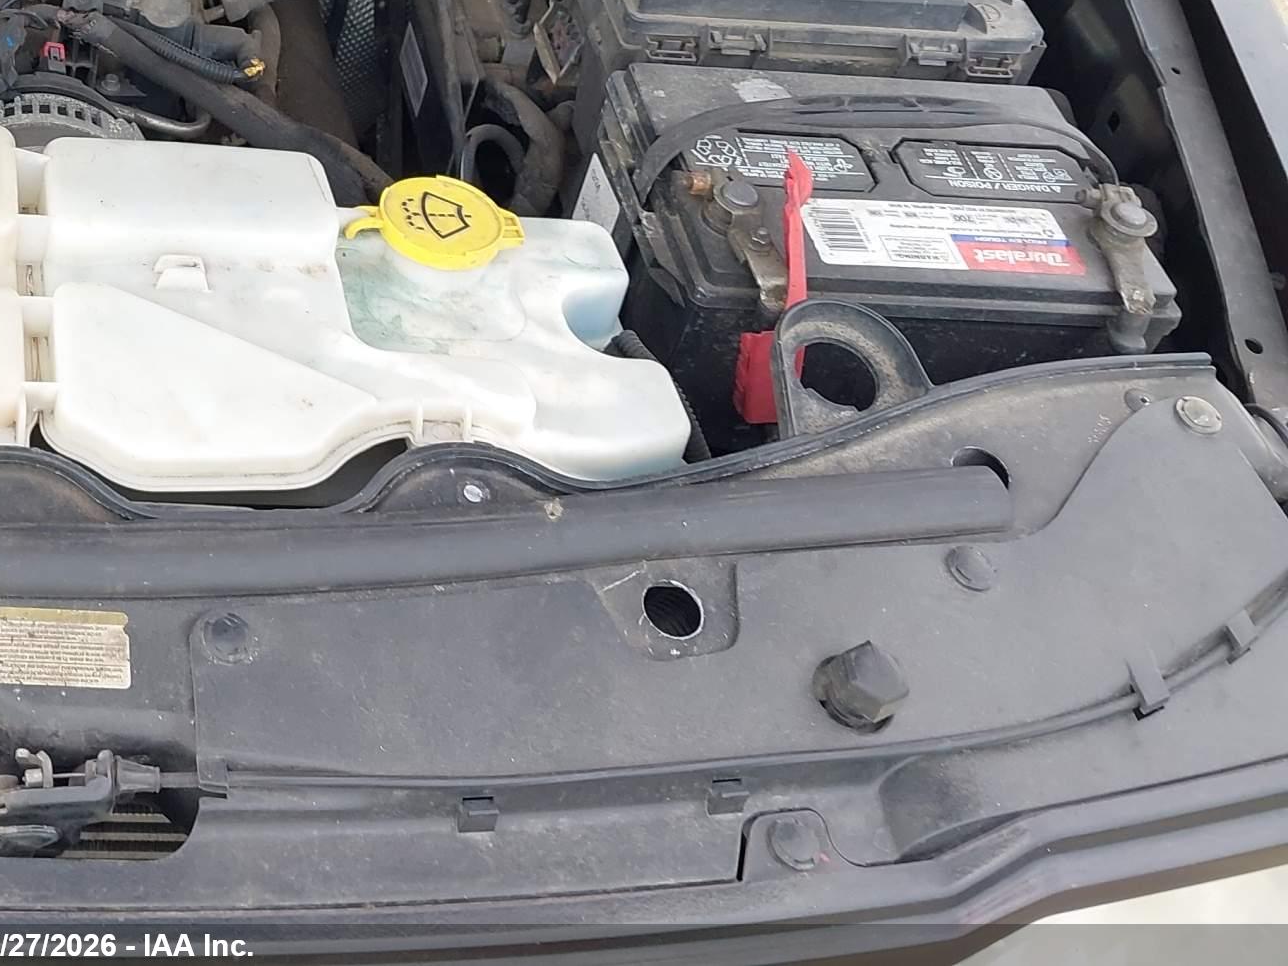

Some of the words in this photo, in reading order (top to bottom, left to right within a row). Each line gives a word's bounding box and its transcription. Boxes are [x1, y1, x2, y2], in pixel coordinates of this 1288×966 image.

[948, 179, 991, 189] POISON
[1002, 182, 1051, 193] DANGER
[973, 248, 1070, 267] Duralast
